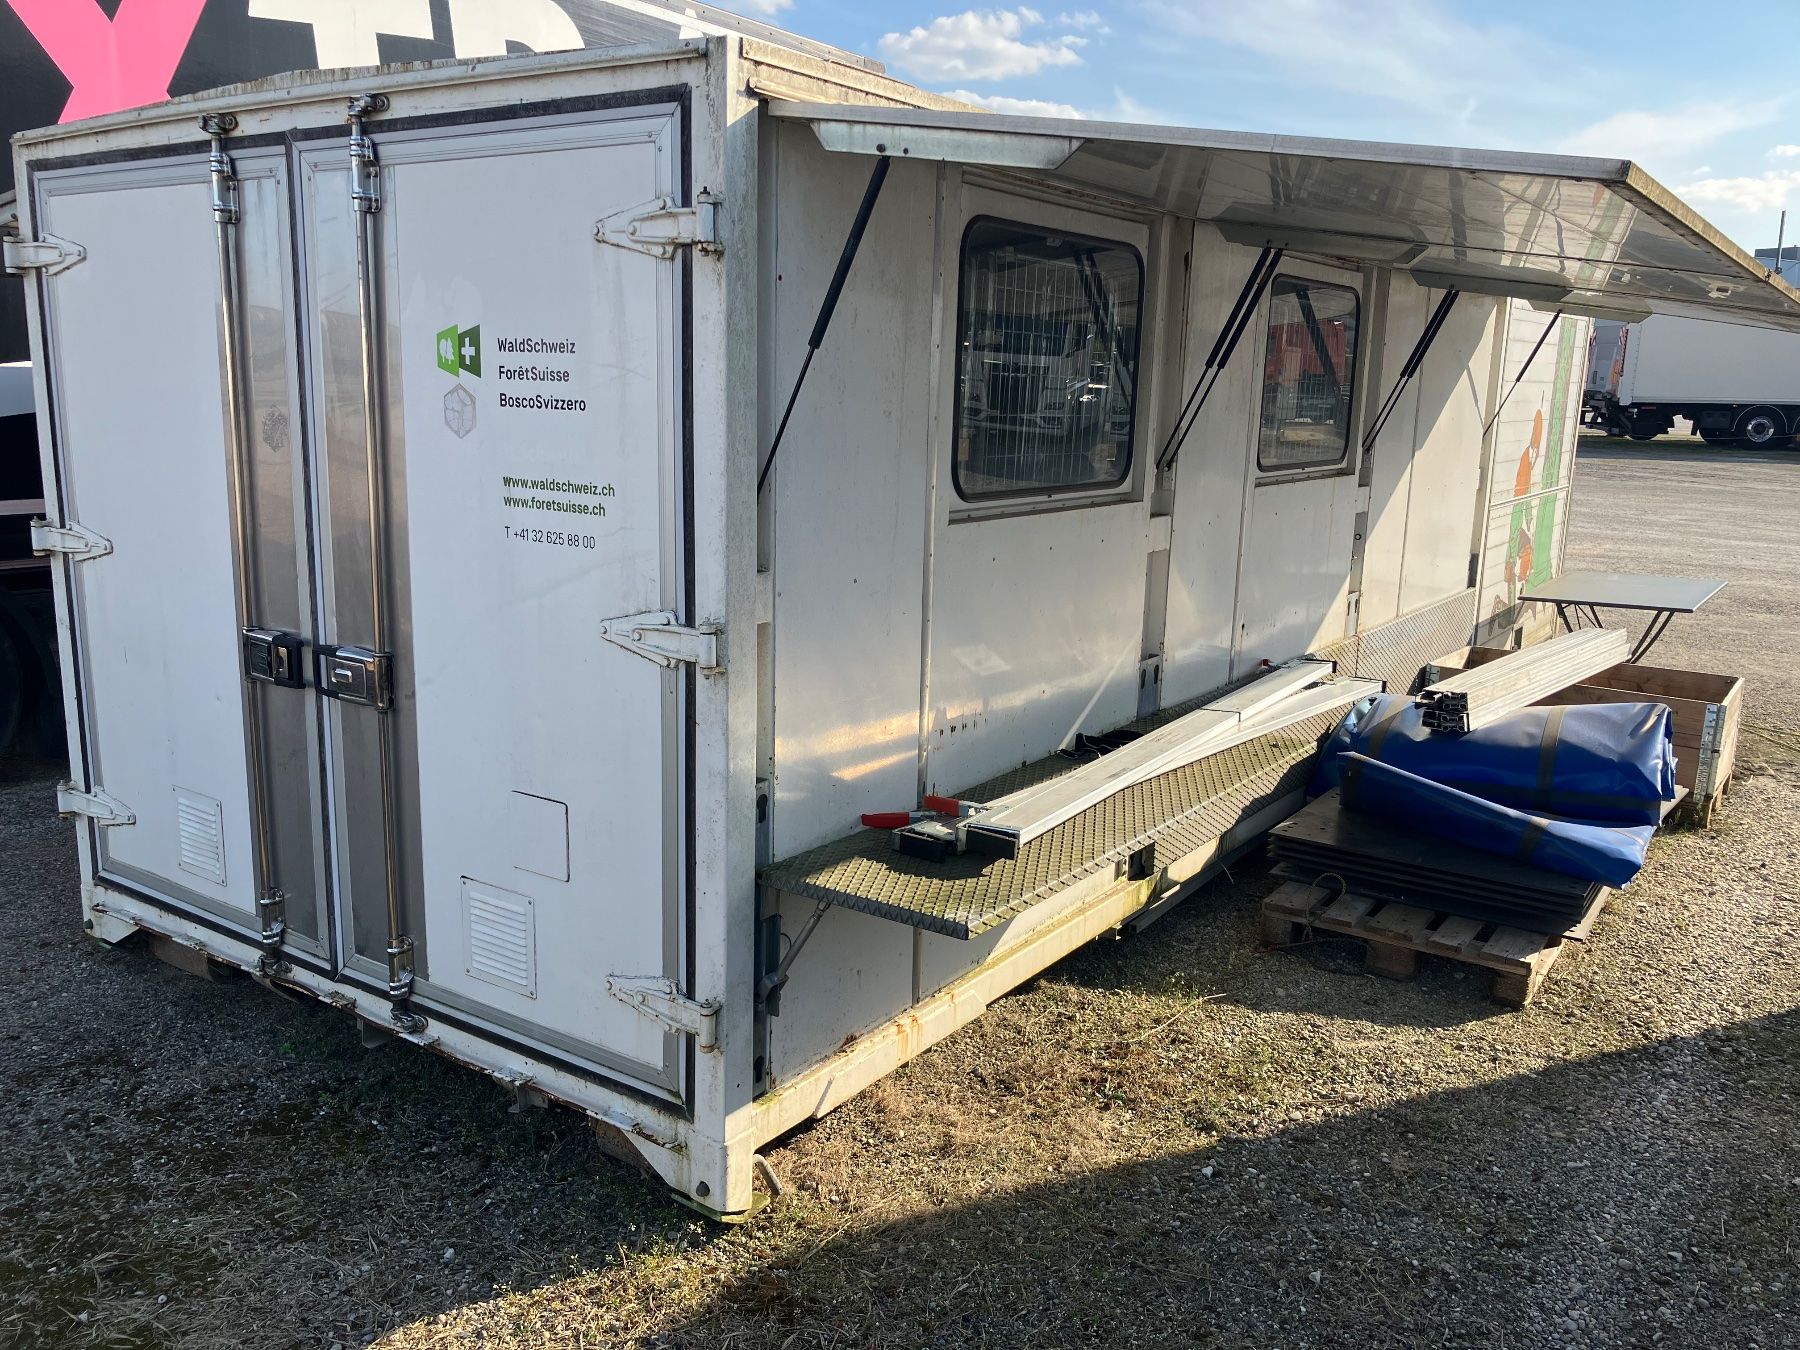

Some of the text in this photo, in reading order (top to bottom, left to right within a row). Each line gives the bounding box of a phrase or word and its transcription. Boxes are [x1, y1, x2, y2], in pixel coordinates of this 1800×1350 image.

[497, 337, 576, 354] WaldSchweiz
[498, 365, 570, 382] ForêtSuisse
[499, 392, 586, 411] BoscoSvizzero
[502, 476, 616, 497] www.waldschweiz.ch
[503, 496, 606, 517] www.foretsuisse.ch
[504, 525, 596, 549] T +41 32 625 88 00
